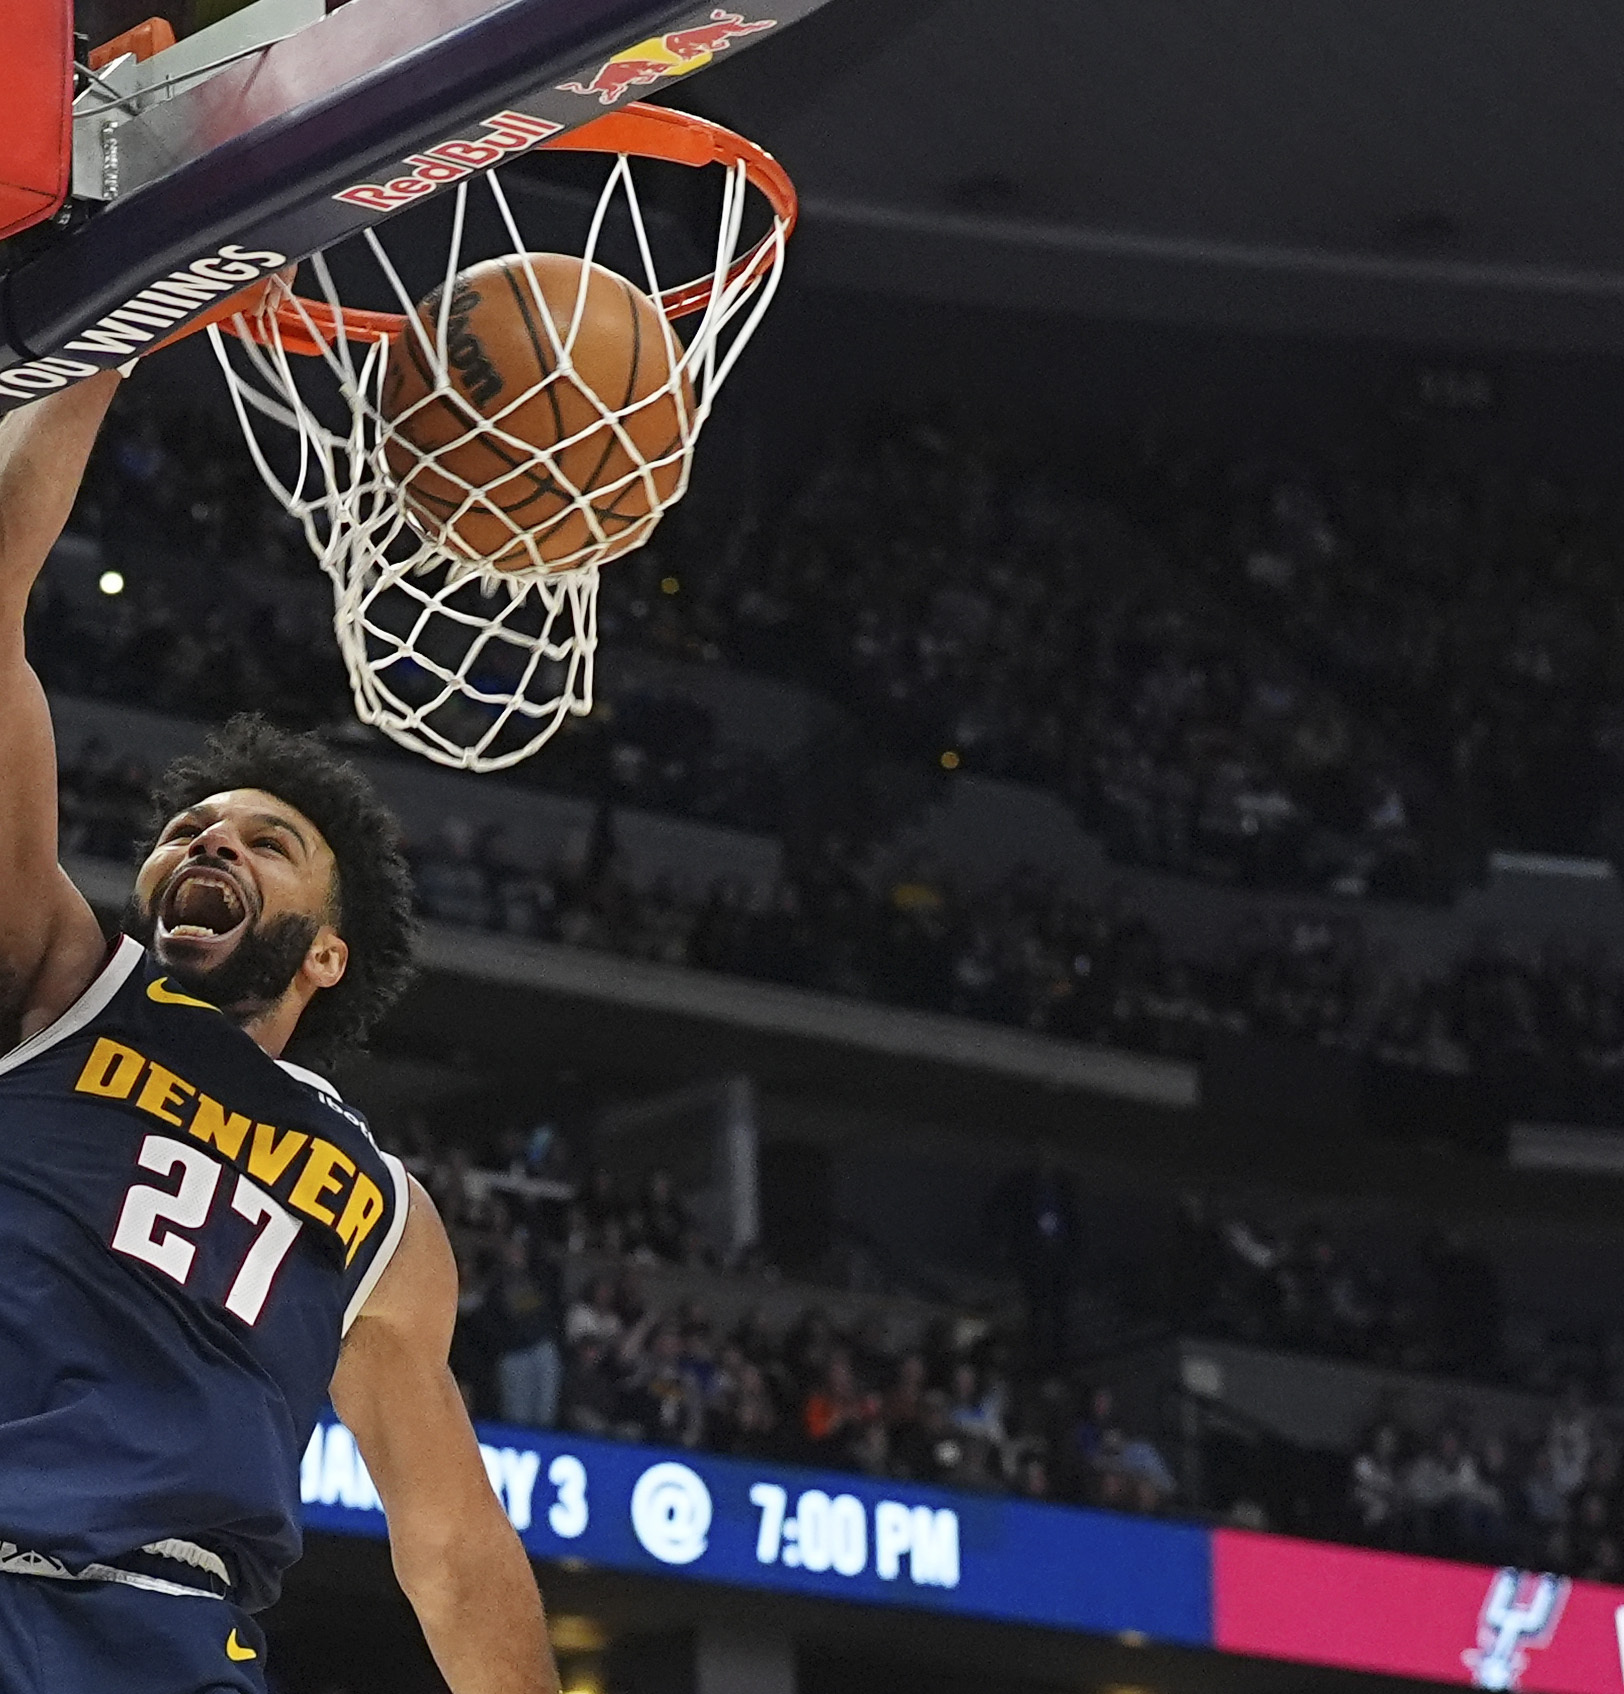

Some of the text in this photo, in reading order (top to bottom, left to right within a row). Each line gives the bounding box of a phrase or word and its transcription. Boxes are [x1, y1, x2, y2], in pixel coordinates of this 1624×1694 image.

[63, 244, 287, 355] WIIINGS
[75, 1036, 384, 1270] DENVER
[111, 1133, 304, 1327] 27
[549, 1454, 588, 1539] 3
[631, 1461, 712, 1564] @
[750, 1484, 867, 1577] 7:00
[875, 1501, 960, 1588] PM
